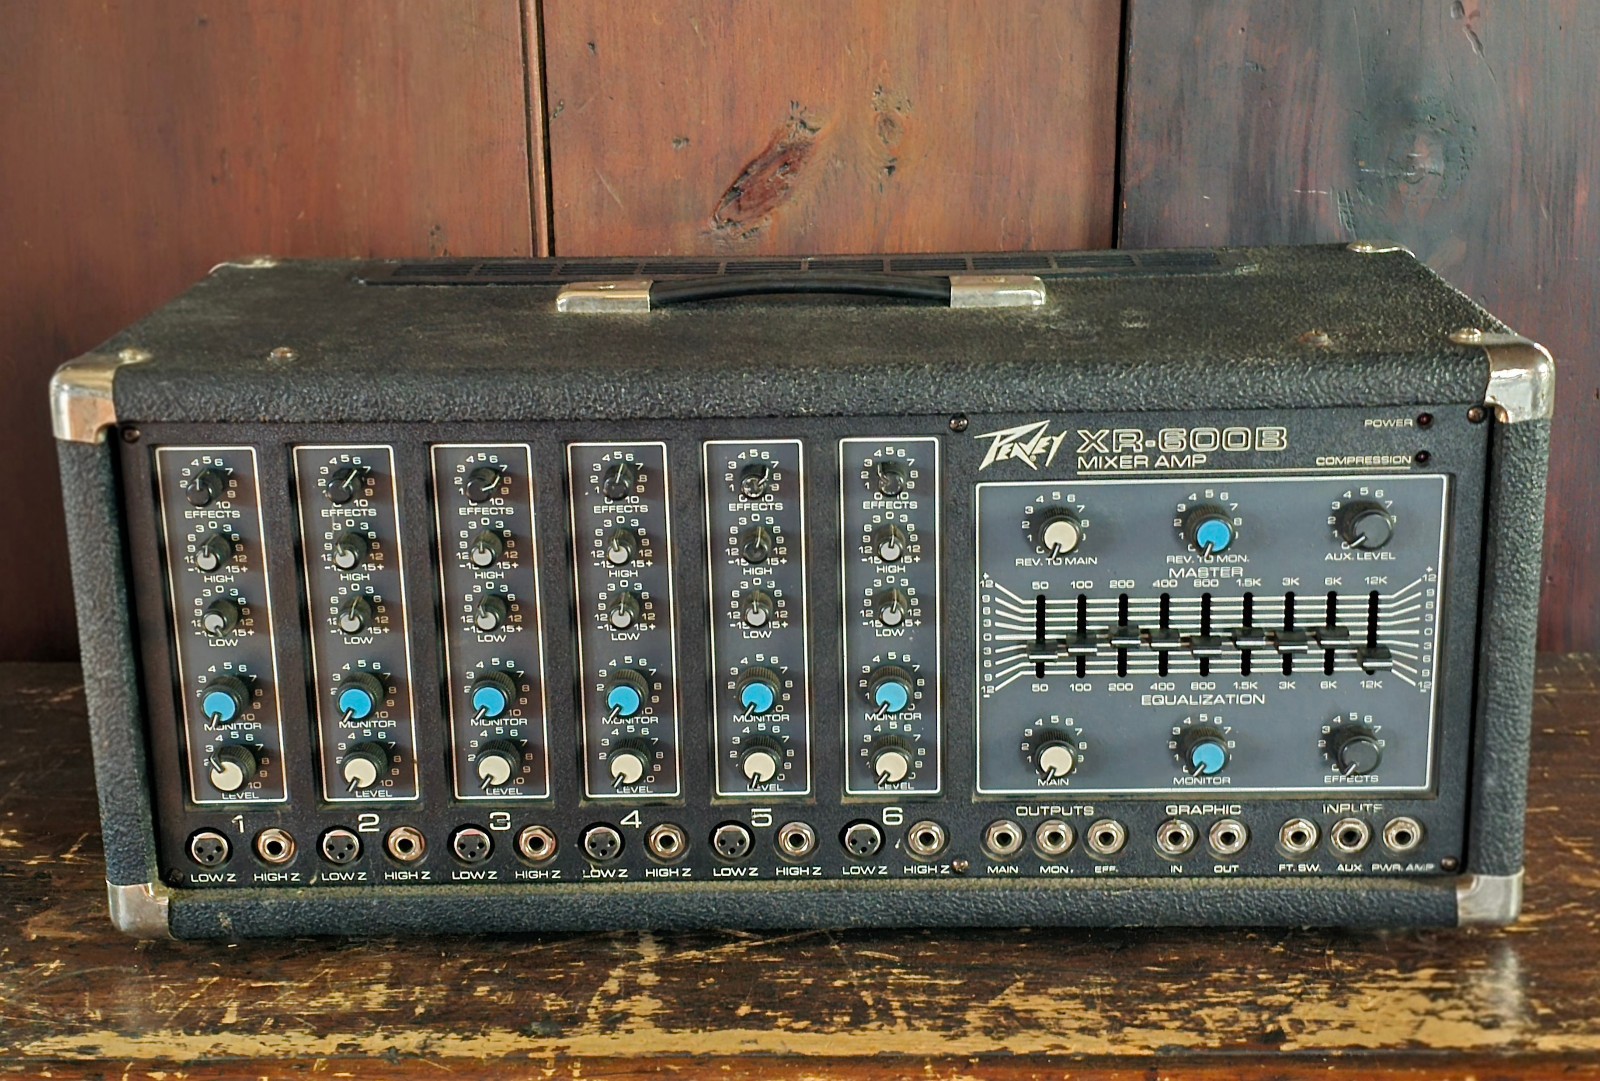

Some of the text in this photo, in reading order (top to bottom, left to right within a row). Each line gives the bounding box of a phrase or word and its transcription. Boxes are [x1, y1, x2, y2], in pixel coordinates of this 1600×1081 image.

[1364, 418, 1412, 428] POWER
[1077, 427, 1287, 453] XR-600B
[885, 447, 894, 455] 5
[203, 456, 211, 464] 5
[341, 455, 350, 463] 5
[477, 453, 486, 461] 5
[614, 452, 623, 460] 5
[1315, 455, 1412, 465] COMPRESSION
[1077, 454, 1207, 469] MIXER AMP
[1360, 487, 1368, 495] 5
[1375, 490, 1383, 498] 6
[625, 496, 639, 504] 10
[1052, 492, 1060, 500] 5
[216, 501, 230, 509] 10
[489, 498, 504, 506] 10
[1332, 501, 1340, 510] 3
[594, 505, 648, 513] EFFECTS
[729, 503, 783, 511] EFFECTS
[1077, 505, 1085, 513] 7
[184, 510, 240, 519] EFFECTS
[321, 509, 377, 517] EFFECTS
[725, 548, 739, 556] 12
[1357, 552, 1396, 560] LEVEL
[1016, 557, 1097, 566] REV. TO MAIN
[1167, 556, 1194, 564] REV.
[609, 570, 638, 578] HIGH
[743, 567, 772, 575] HIGH
[1169, 567, 1243, 578] MASTER
[204, 575, 234, 583] HIGH
[340, 573, 370, 581] HIGH
[1325, 577, 1342, 585] 6K
[1364, 576, 1387, 584] 12K
[1422, 574, 1436, 582] 12
[1032, 582, 1049, 590] 50
[1070, 581, 1093, 589] 100
[1110, 580, 1134, 588] 200
[1153, 579, 1178, 588] 400
[1194, 579, 1219, 588] 800
[1282, 578, 1300, 586] 3K
[611, 633, 640, 641] LOW
[876, 629, 904, 637] LOW
[344, 637, 373, 645] LOW
[478, 634, 506, 642] LOW
[209, 639, 238, 647] LOW
[1032, 684, 1048, 692] 50
[1070, 683, 1092, 691] 100
[1108, 683, 1133, 691] 200
[1150, 682, 1175, 691] 400
[1191, 682, 1216, 690] 800
[1279, 681, 1296, 690] 3K
[1320, 681, 1337, 689] 6K
[1360, 681, 1382, 689] 12K
[1142, 694, 1265, 705] EQUALIZATION
[602, 716, 658, 724] MONITOR
[733, 714, 790, 722] MONITOR
[865, 713, 921, 721] MONITOR
[1051, 715, 1059, 723] 5
[471, 718, 527, 726] MONITOR
[1038, 778, 1069, 786] MAIN
[1173, 777, 1230, 785] MONITOR
[1324, 775, 1379, 783] EFFECTS
[356, 790, 393, 798] LEVEL
[1016, 806, 1094, 816] OUTPUTS
[1166, 804, 1241, 815] GRAPHIC
[620, 810, 642, 828] 4
[751, 808, 772, 827] 5
[882, 807, 904, 825] 6
[231, 815, 244, 833] 1
[358, 814, 379, 832] 2
[490, 812, 511, 830] 3
[713, 868, 758, 876] LOW Z
[776, 867, 822, 876] HIGH Z
[842, 866, 887, 875] LOW Z
[904, 866, 950, 874] HIGH Z
[987, 866, 1018, 874] MAIN
[1040, 866, 1074, 874] MON.
[1170, 865, 1182, 873] IN
[1214, 865, 1239, 873] OUT
[1279, 864, 1321, 872] FT. SW.
[1406, 864, 1435, 872] AMP
[322, 872, 366, 881] LOW Z
[385, 871, 431, 880] HIGH Z
[452, 871, 497, 880] LOW Z
[515, 870, 560, 879] HIGH Z
[583, 869, 628, 878] LOW Z
[646, 868, 691, 877] HIGH Z
[191, 874, 236, 882] LOW Z
[254, 873, 300, 882] HIGH Z
